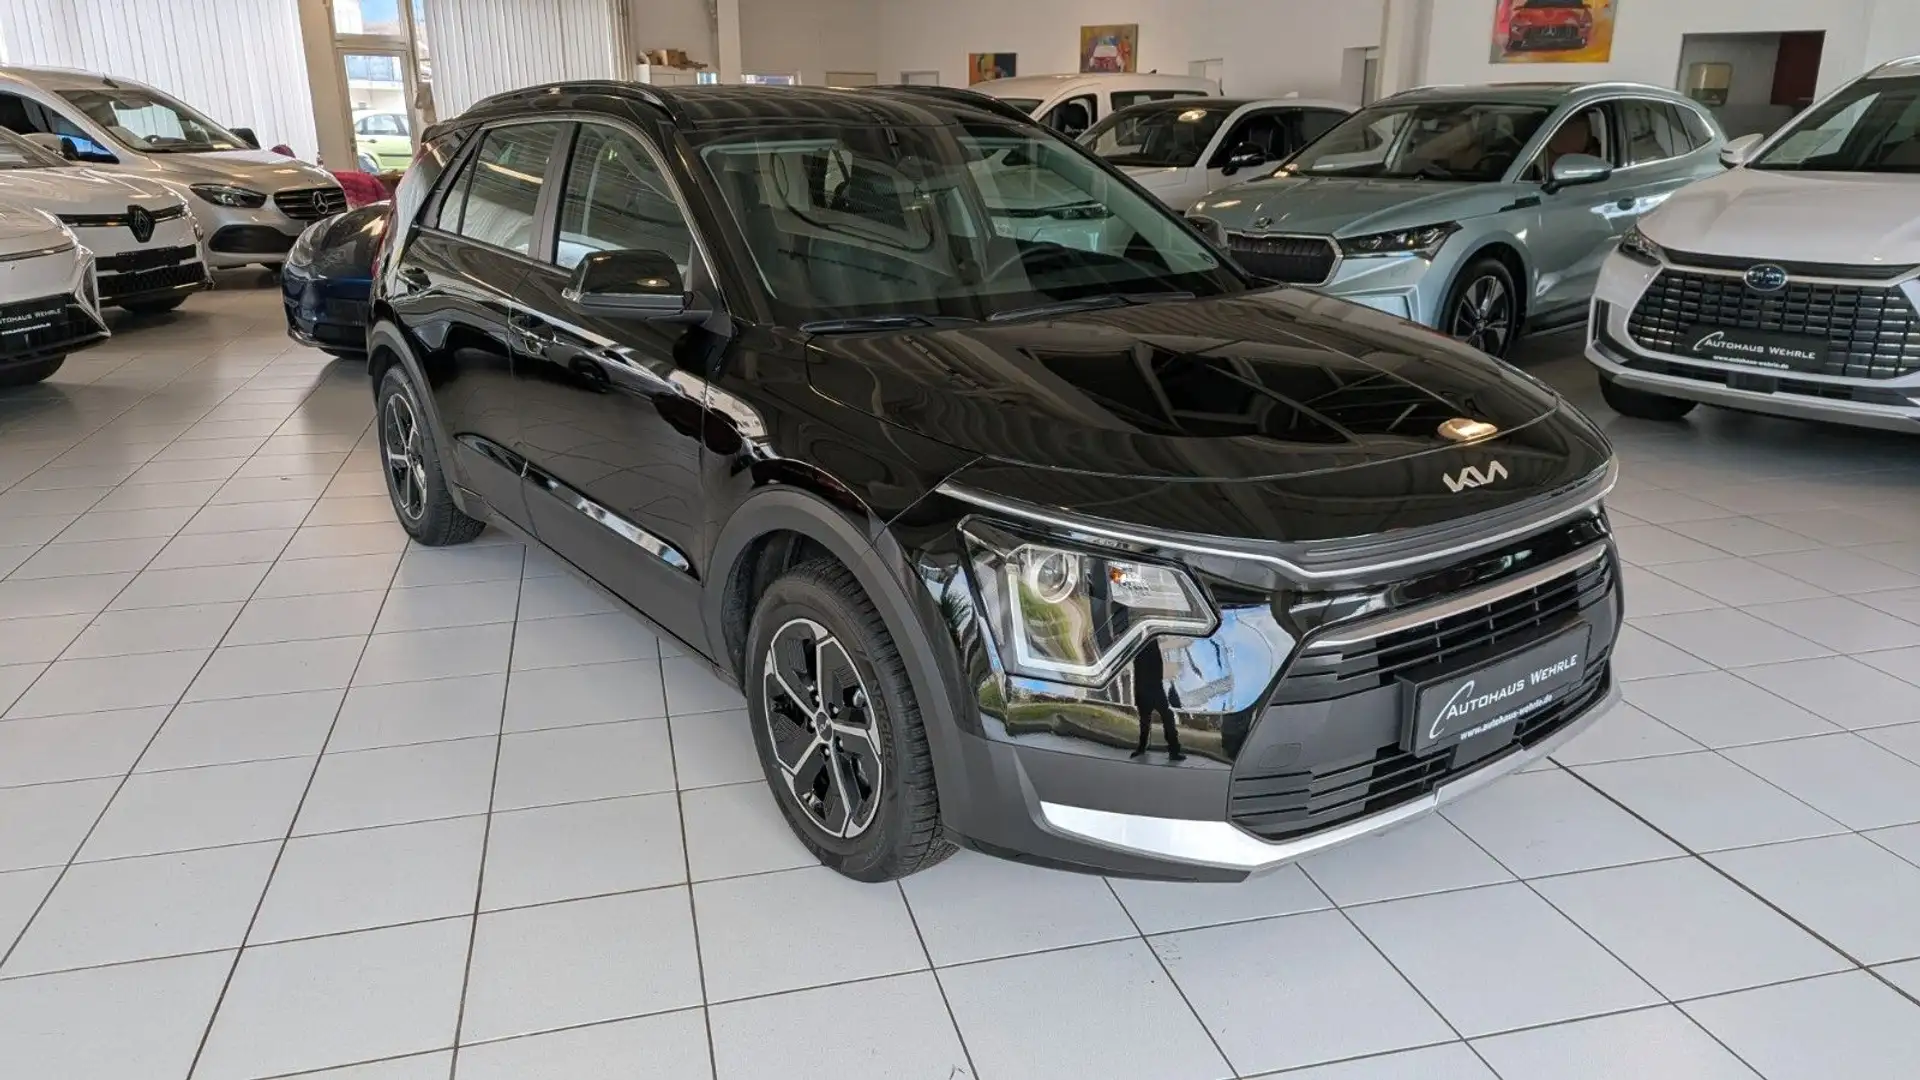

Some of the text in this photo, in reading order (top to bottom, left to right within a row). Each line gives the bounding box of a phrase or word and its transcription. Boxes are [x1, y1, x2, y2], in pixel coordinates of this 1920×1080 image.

[1704, 338, 1816, 359] AUTOHAUS WEHRLE
[1443, 460, 1508, 493] KIA
[1446, 654, 1578, 720] AUTOHAUS WEHRLE
[1460, 693, 1553, 740] www.autohaus-wehrle.de
